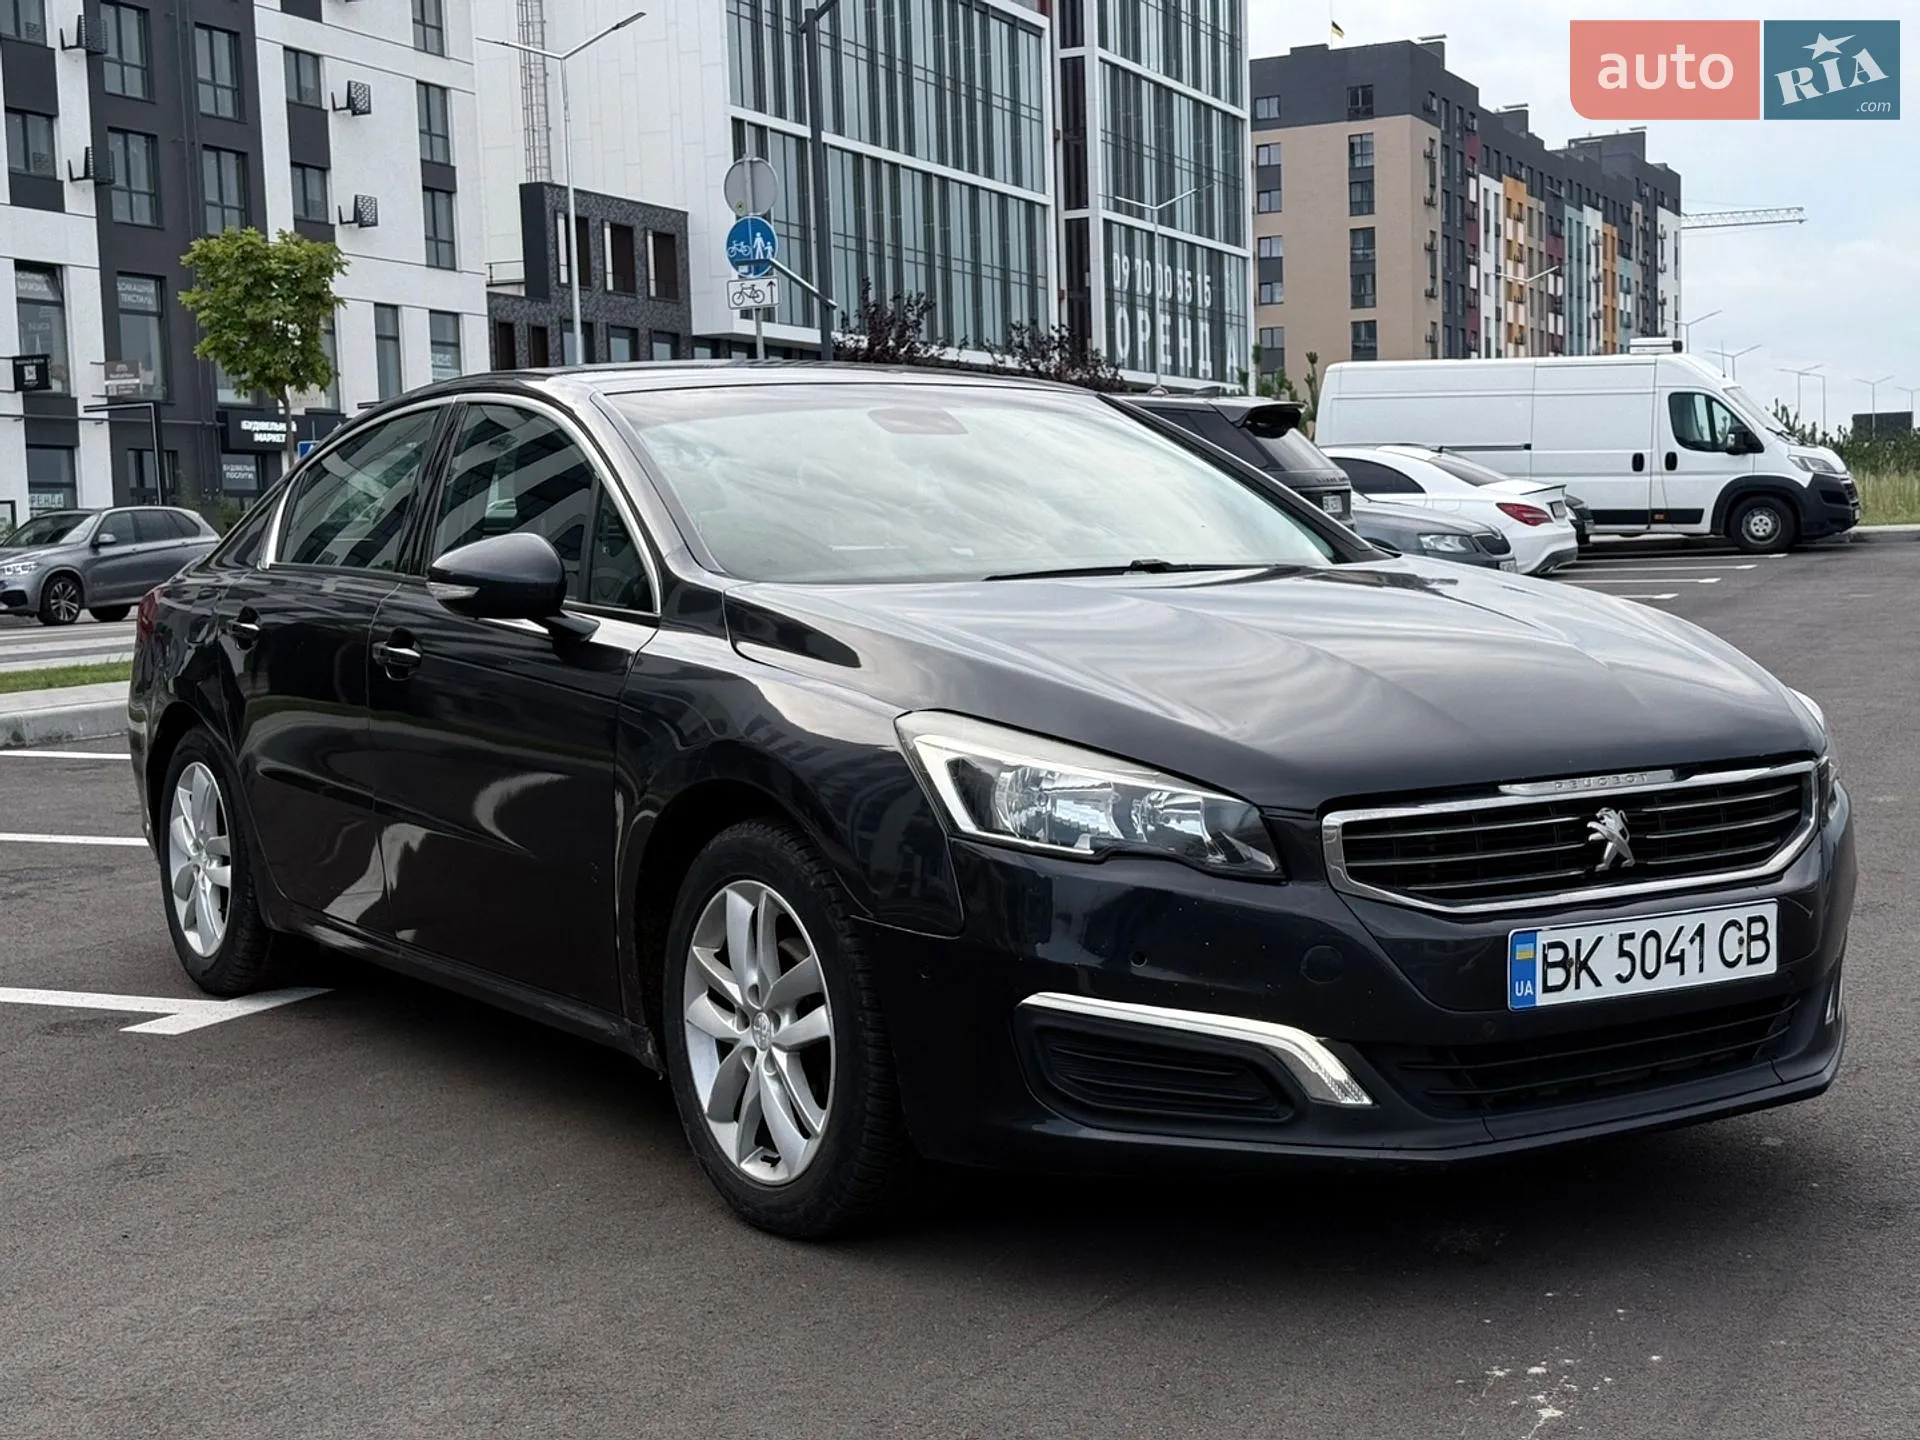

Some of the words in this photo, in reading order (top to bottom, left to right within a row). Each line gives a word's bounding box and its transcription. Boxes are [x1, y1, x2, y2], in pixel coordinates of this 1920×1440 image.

[1112, 252, 1130, 292] 09
[1115, 306, 1240, 383] ОРЕНДА
[254, 433, 286, 442] МАРКЕТ
[29, 494, 64, 507] РЕНДА
[1555, 773, 1648, 790] PEUGEOT
[1541, 935, 1604, 994] BK
[1614, 922, 1706, 985] 5041
[1718, 914, 1771, 970] CB
[1515, 980, 1535, 997] UA
